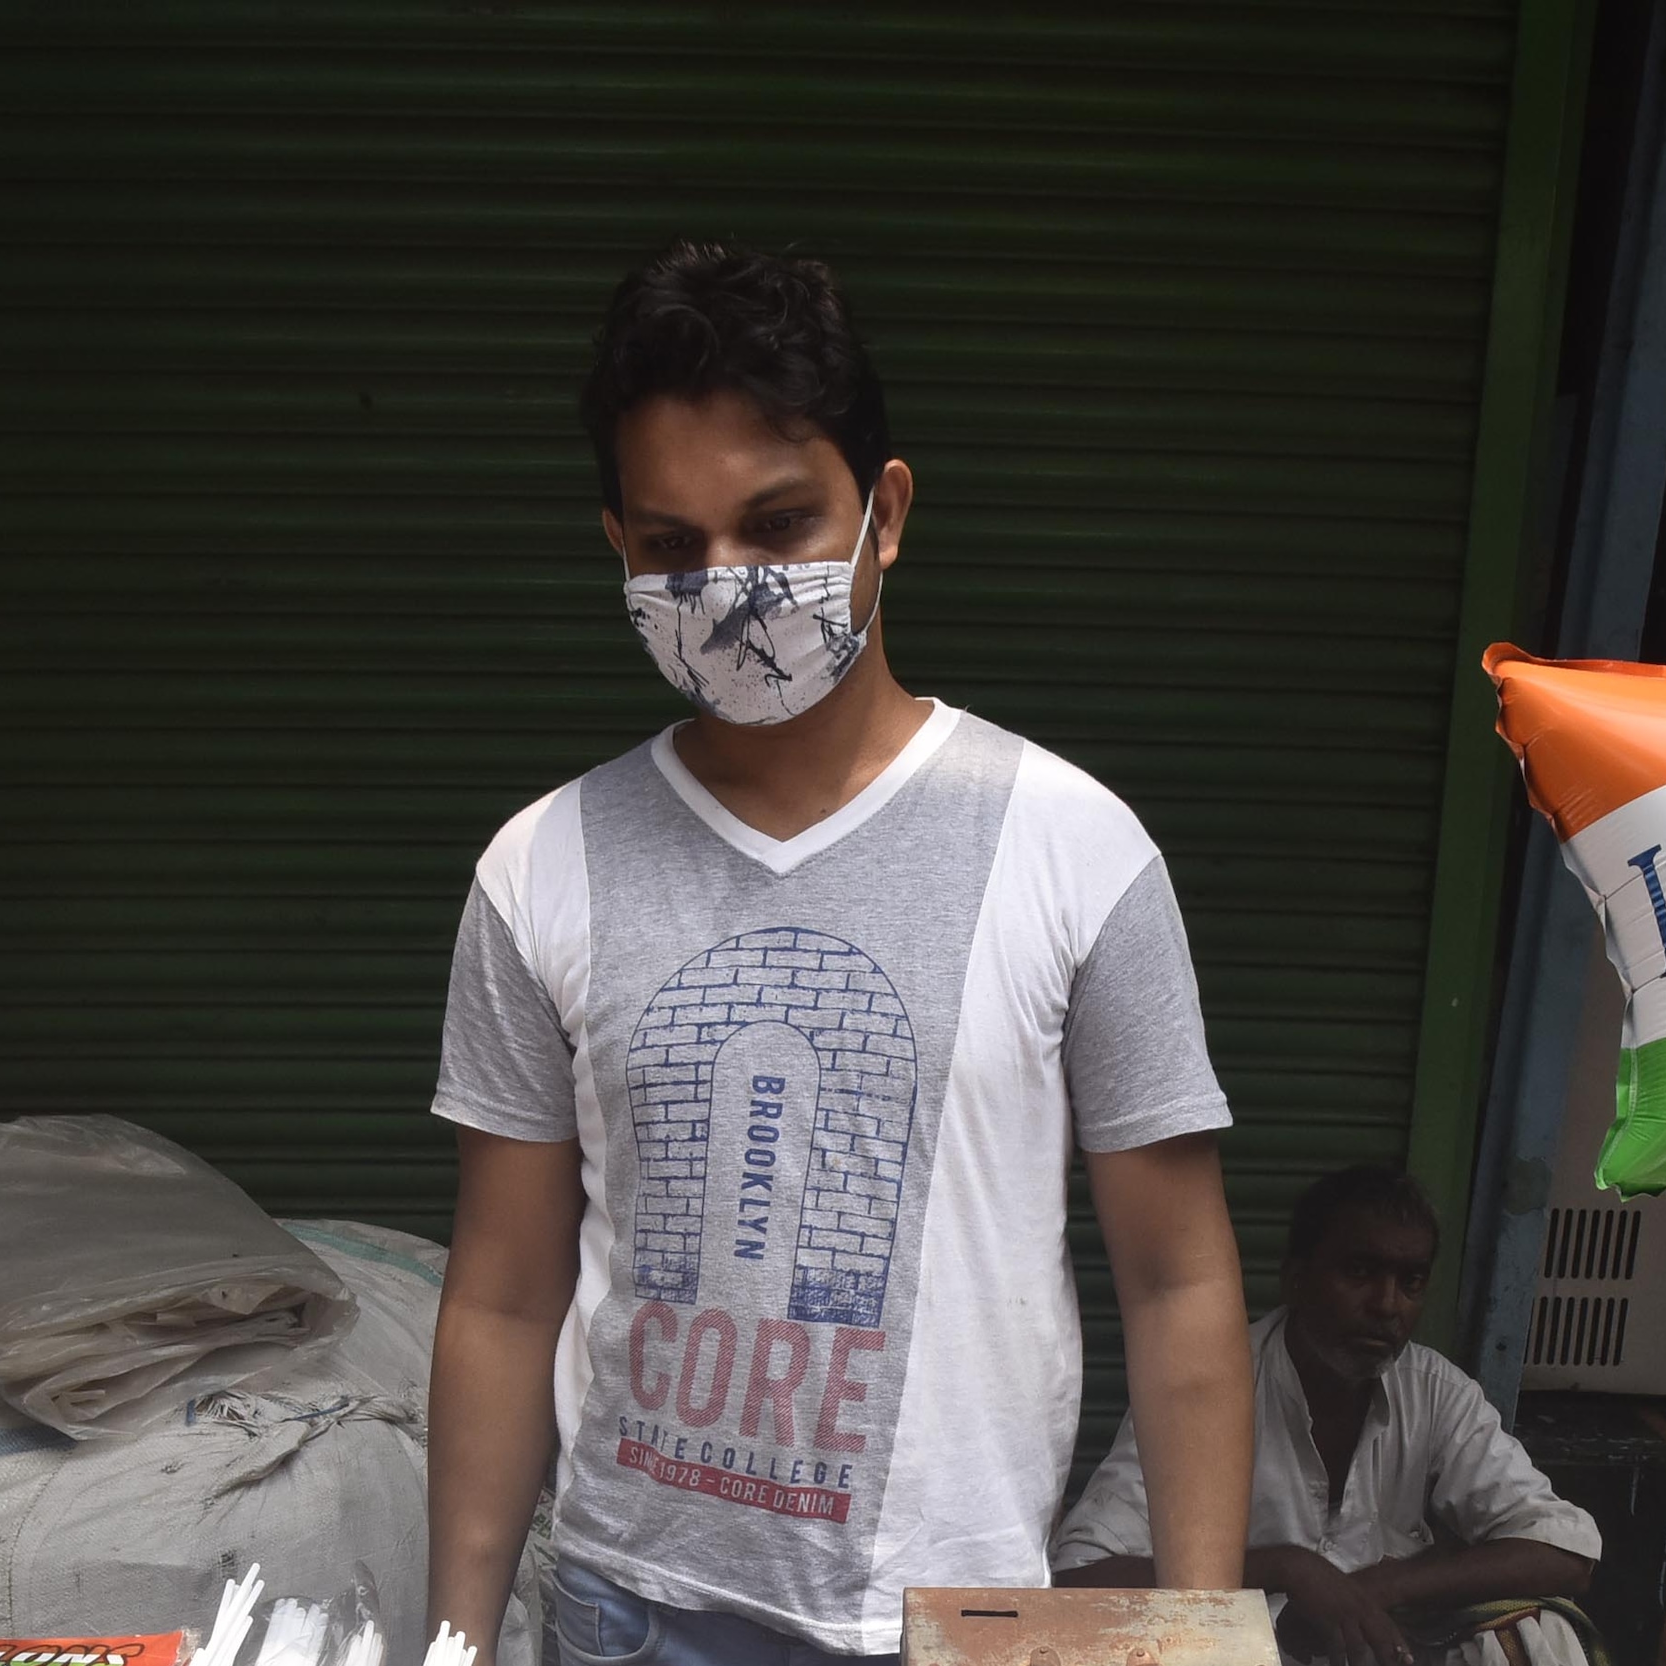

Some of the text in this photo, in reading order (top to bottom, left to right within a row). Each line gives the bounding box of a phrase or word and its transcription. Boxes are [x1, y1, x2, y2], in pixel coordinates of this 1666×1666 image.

[734, 1073, 787, 1262] BROOKLYN
[628, 1300, 887, 1454] CORE
[619, 1415, 853, 1489] STATE COLLEGE
[659, 1460, 702, 1489] 1978
[718, 1471, 768, 1506] CORE
[772, 1485, 834, 1516] DENIM
